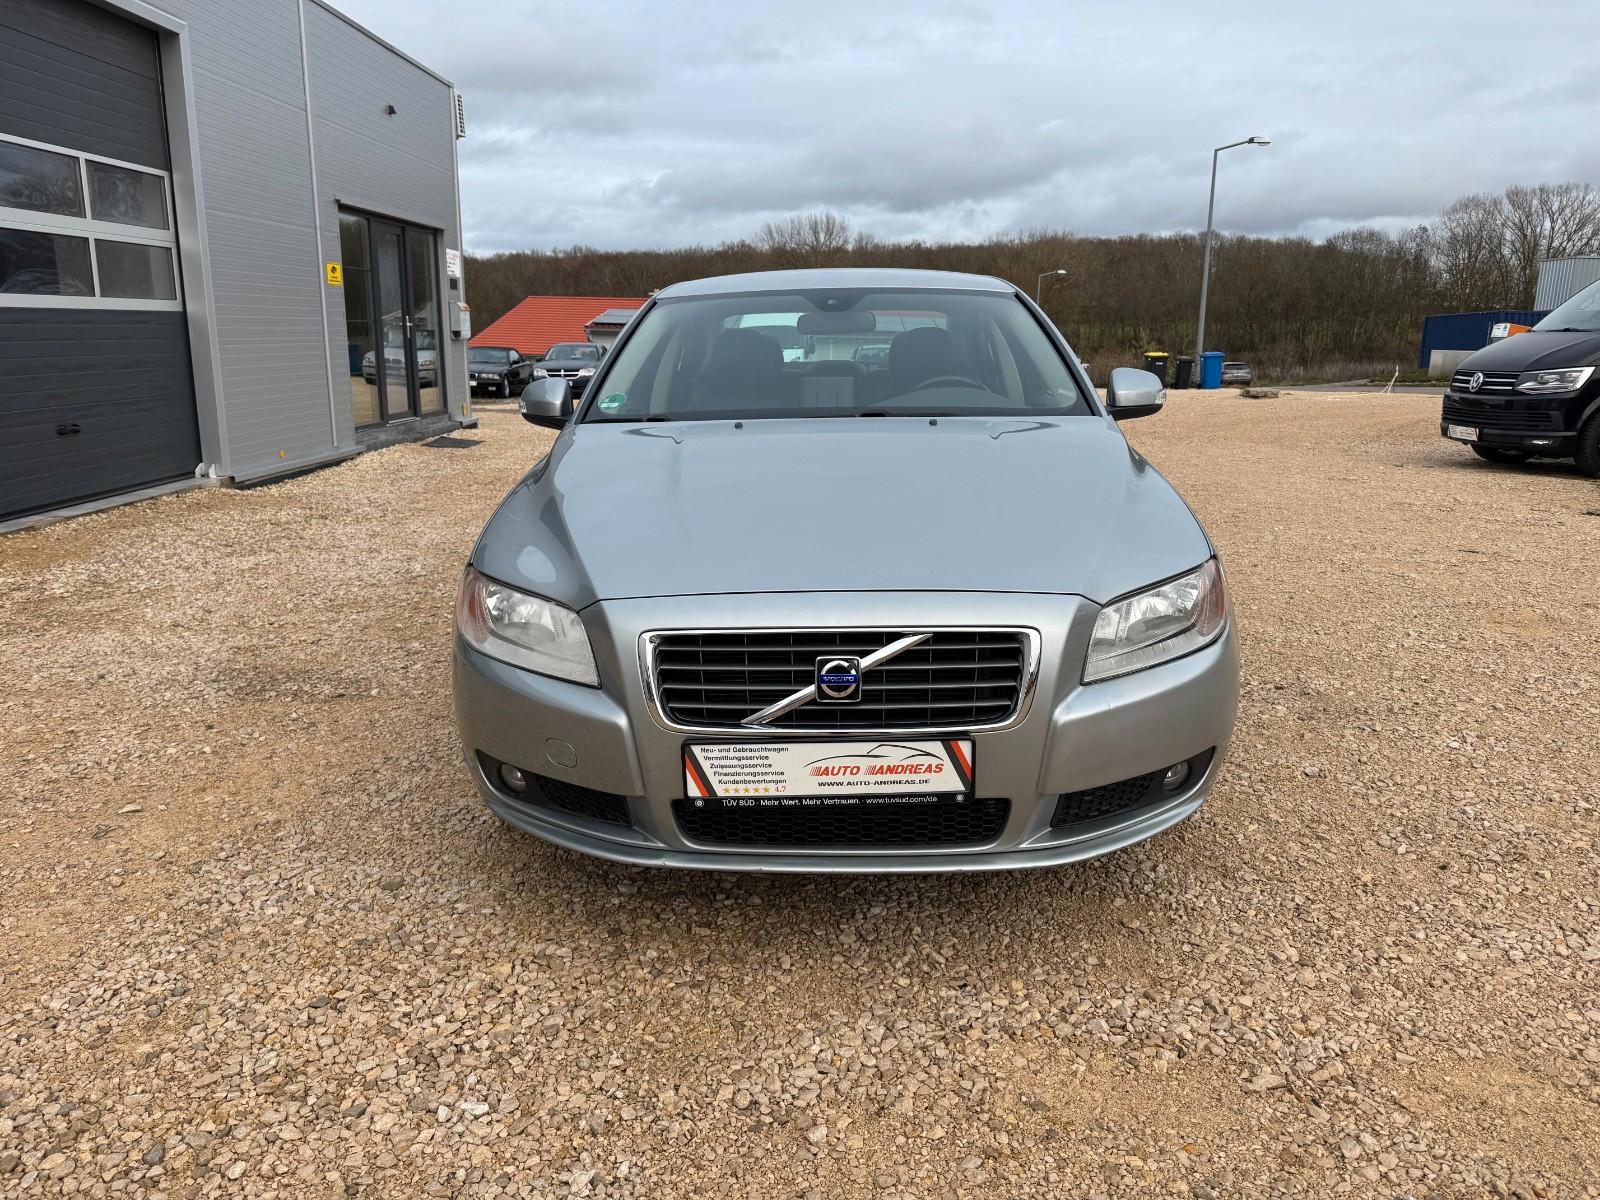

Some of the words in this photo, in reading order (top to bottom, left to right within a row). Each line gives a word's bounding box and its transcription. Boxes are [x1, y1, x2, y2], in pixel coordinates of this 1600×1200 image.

[732, 746, 789, 755] Gebrauchtwagen
[820, 765, 861, 776] AUTO
[873, 763, 945, 775] ANDREAS
[718, 778, 787, 786] Kundenbewertungen
[817, 779, 931, 787] WWW.AUTO-ANDREAS.DE
[722, 798, 737, 807] TÜV
[738, 798, 755, 807] SÜD
[779, 798, 801, 806] Wert.
[802, 798, 821, 806] Mehr
[822, 797, 861, 805] Vertrauen.
